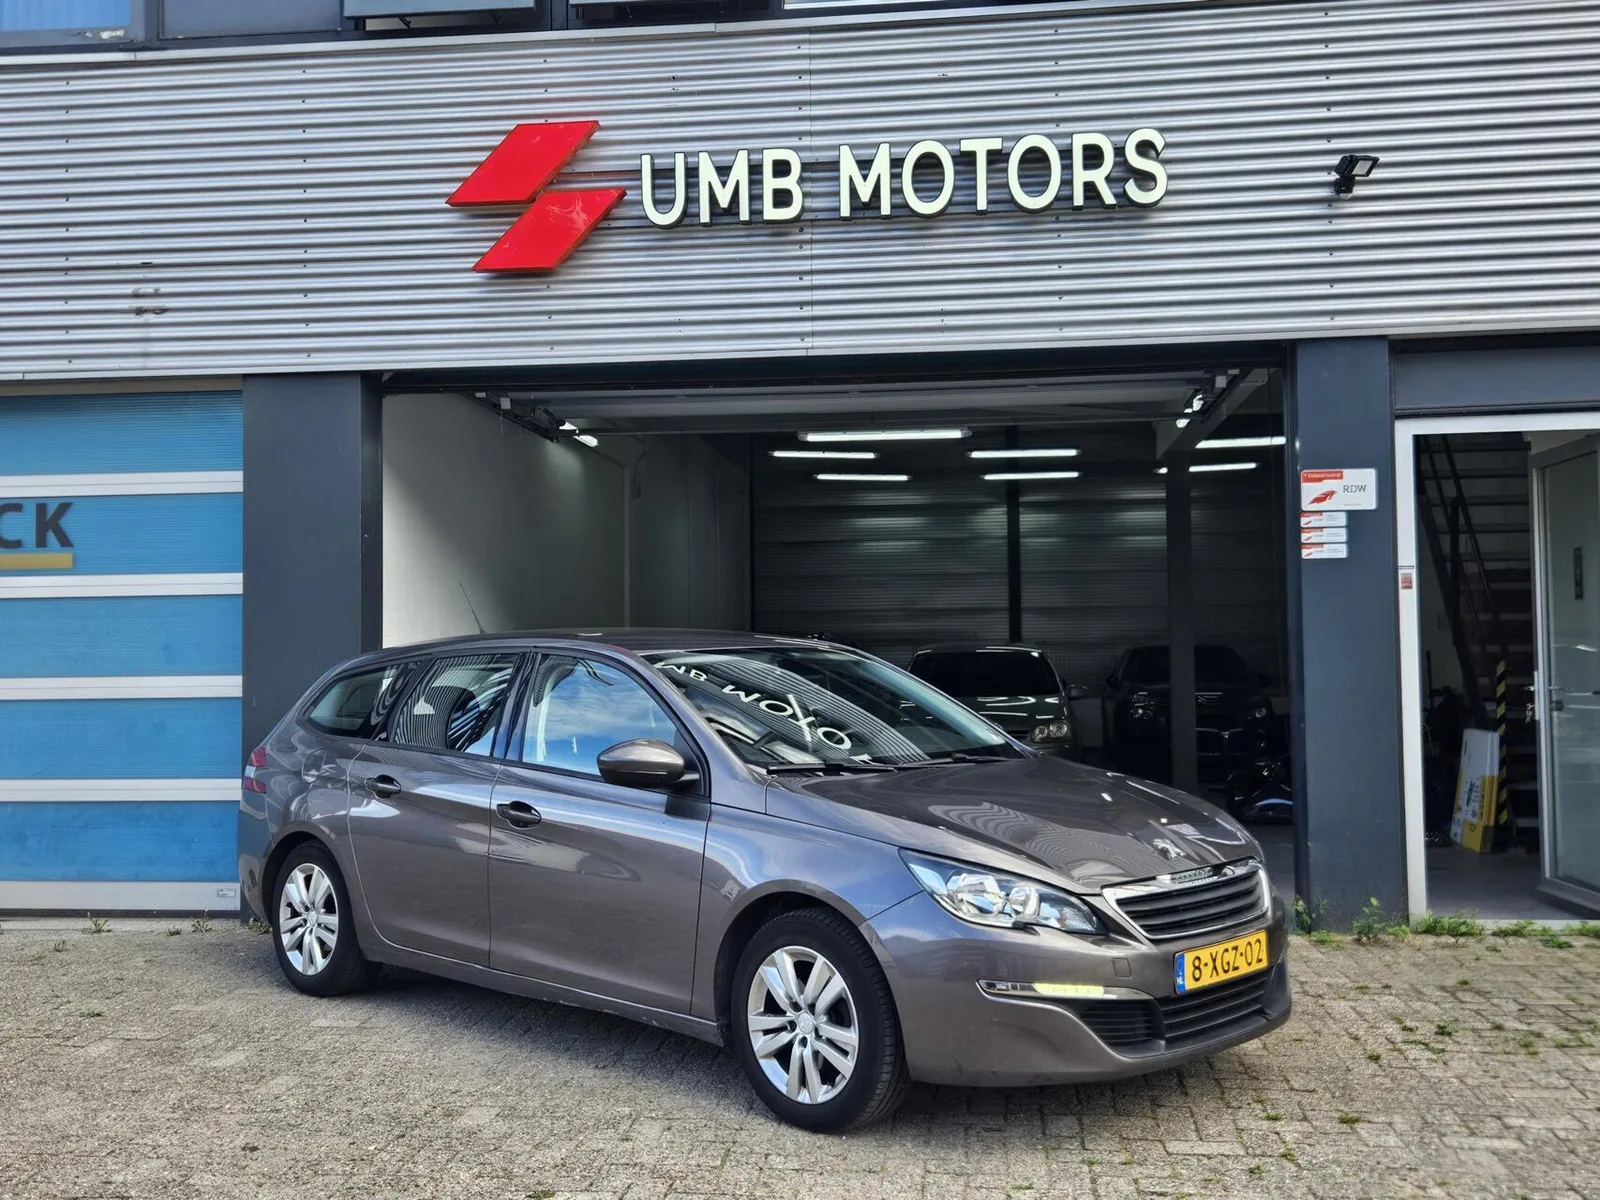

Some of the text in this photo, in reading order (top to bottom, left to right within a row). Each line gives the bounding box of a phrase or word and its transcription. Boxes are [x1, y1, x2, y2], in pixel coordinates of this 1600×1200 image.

[640, 127, 1168, 228] UMB MOTORS
[1343, 485, 1367, 493] RDW
[1192, 938, 1264, 983] 8-XGZ-02
